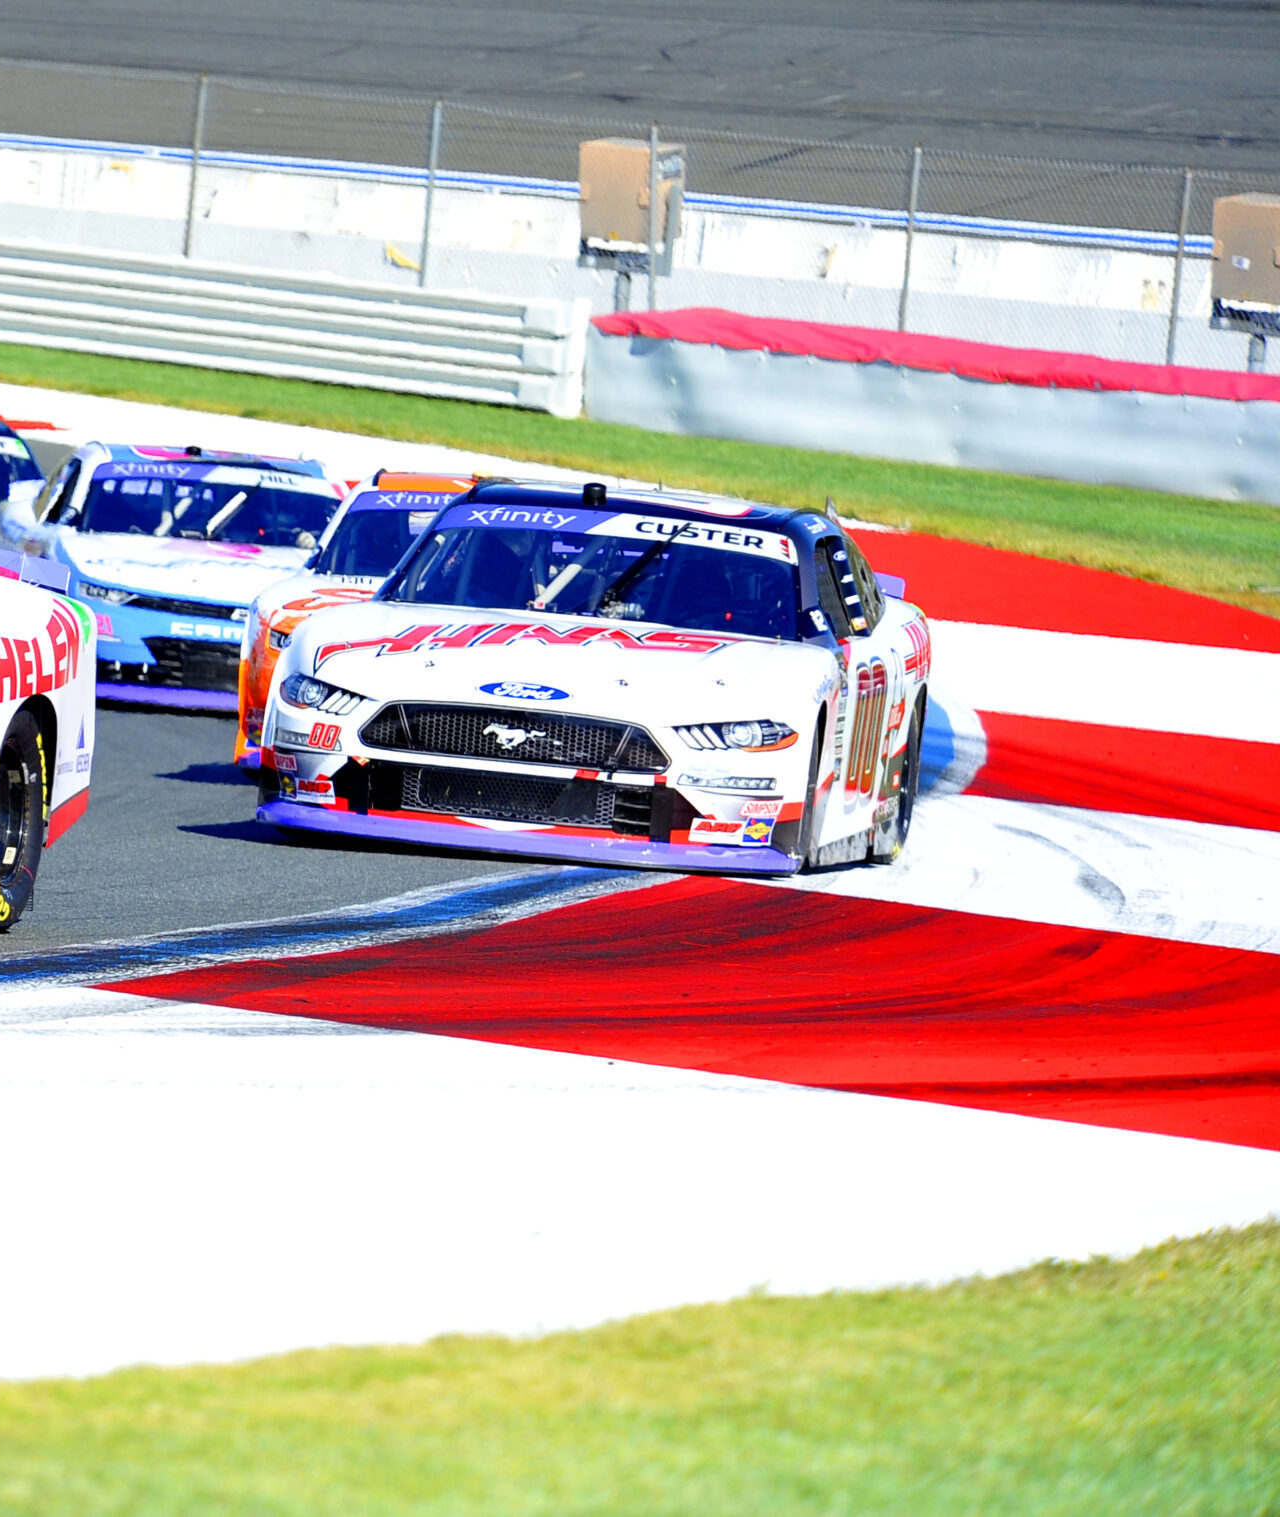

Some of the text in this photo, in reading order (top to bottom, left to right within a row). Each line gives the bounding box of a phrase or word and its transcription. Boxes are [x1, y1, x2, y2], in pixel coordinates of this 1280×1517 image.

[112, 463, 191, 479] xfinity
[260, 473, 298, 486] HILL
[376, 492, 455, 508] xfinit
[466, 507, 577, 529] xfinity
[635, 521, 765, 551] CUSTER
[314, 623, 737, 668] HAAS
[493, 682, 555, 700] Ford
[307, 722, 341, 751] 00
[693, 821, 743, 833] ARP
